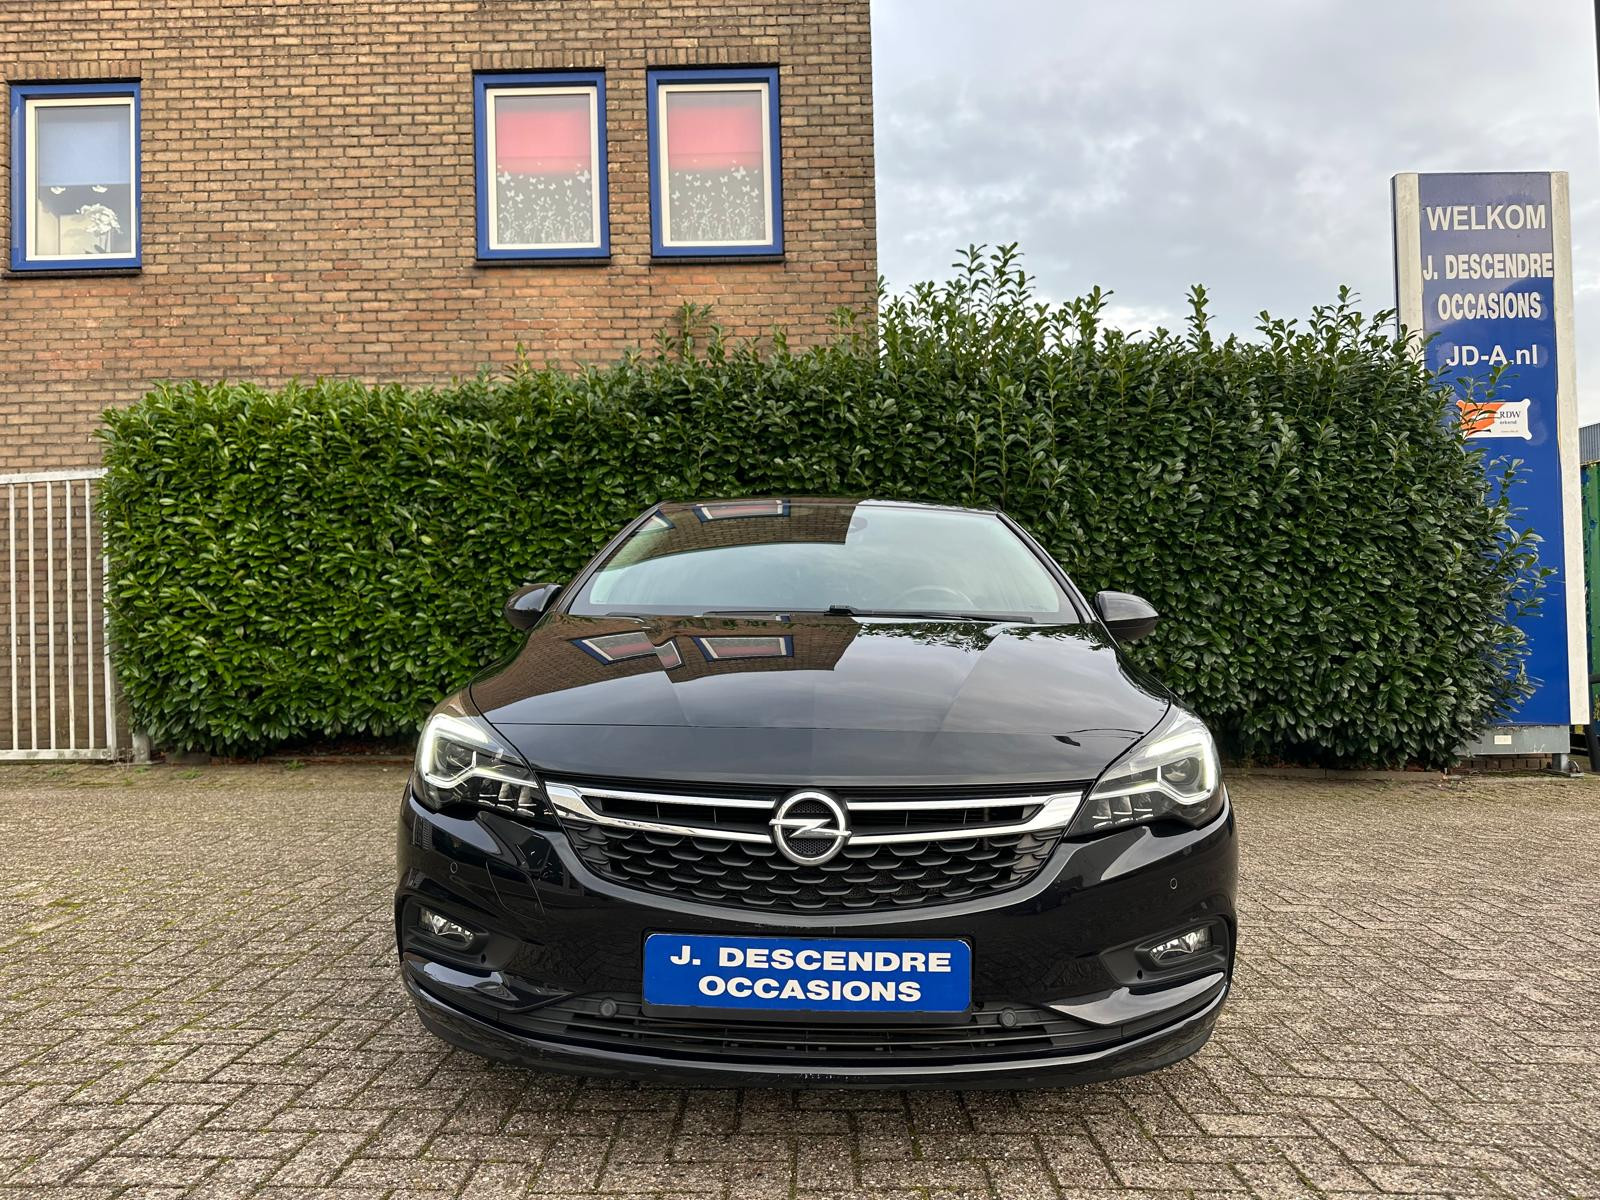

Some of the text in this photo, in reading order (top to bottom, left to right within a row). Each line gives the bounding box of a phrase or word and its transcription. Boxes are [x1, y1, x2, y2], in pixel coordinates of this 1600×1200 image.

[1426, 204, 1546, 231] WELKOM
[1423, 252, 1554, 280] J. DESCENDRE
[1437, 292, 1542, 320] OCCASIONS
[1446, 344, 1538, 366] JD-A.nl
[1499, 411, 1521, 419] RDW
[670, 945, 952, 973] J. DESCENDRE
[698, 975, 921, 1002] OCCASIONS
